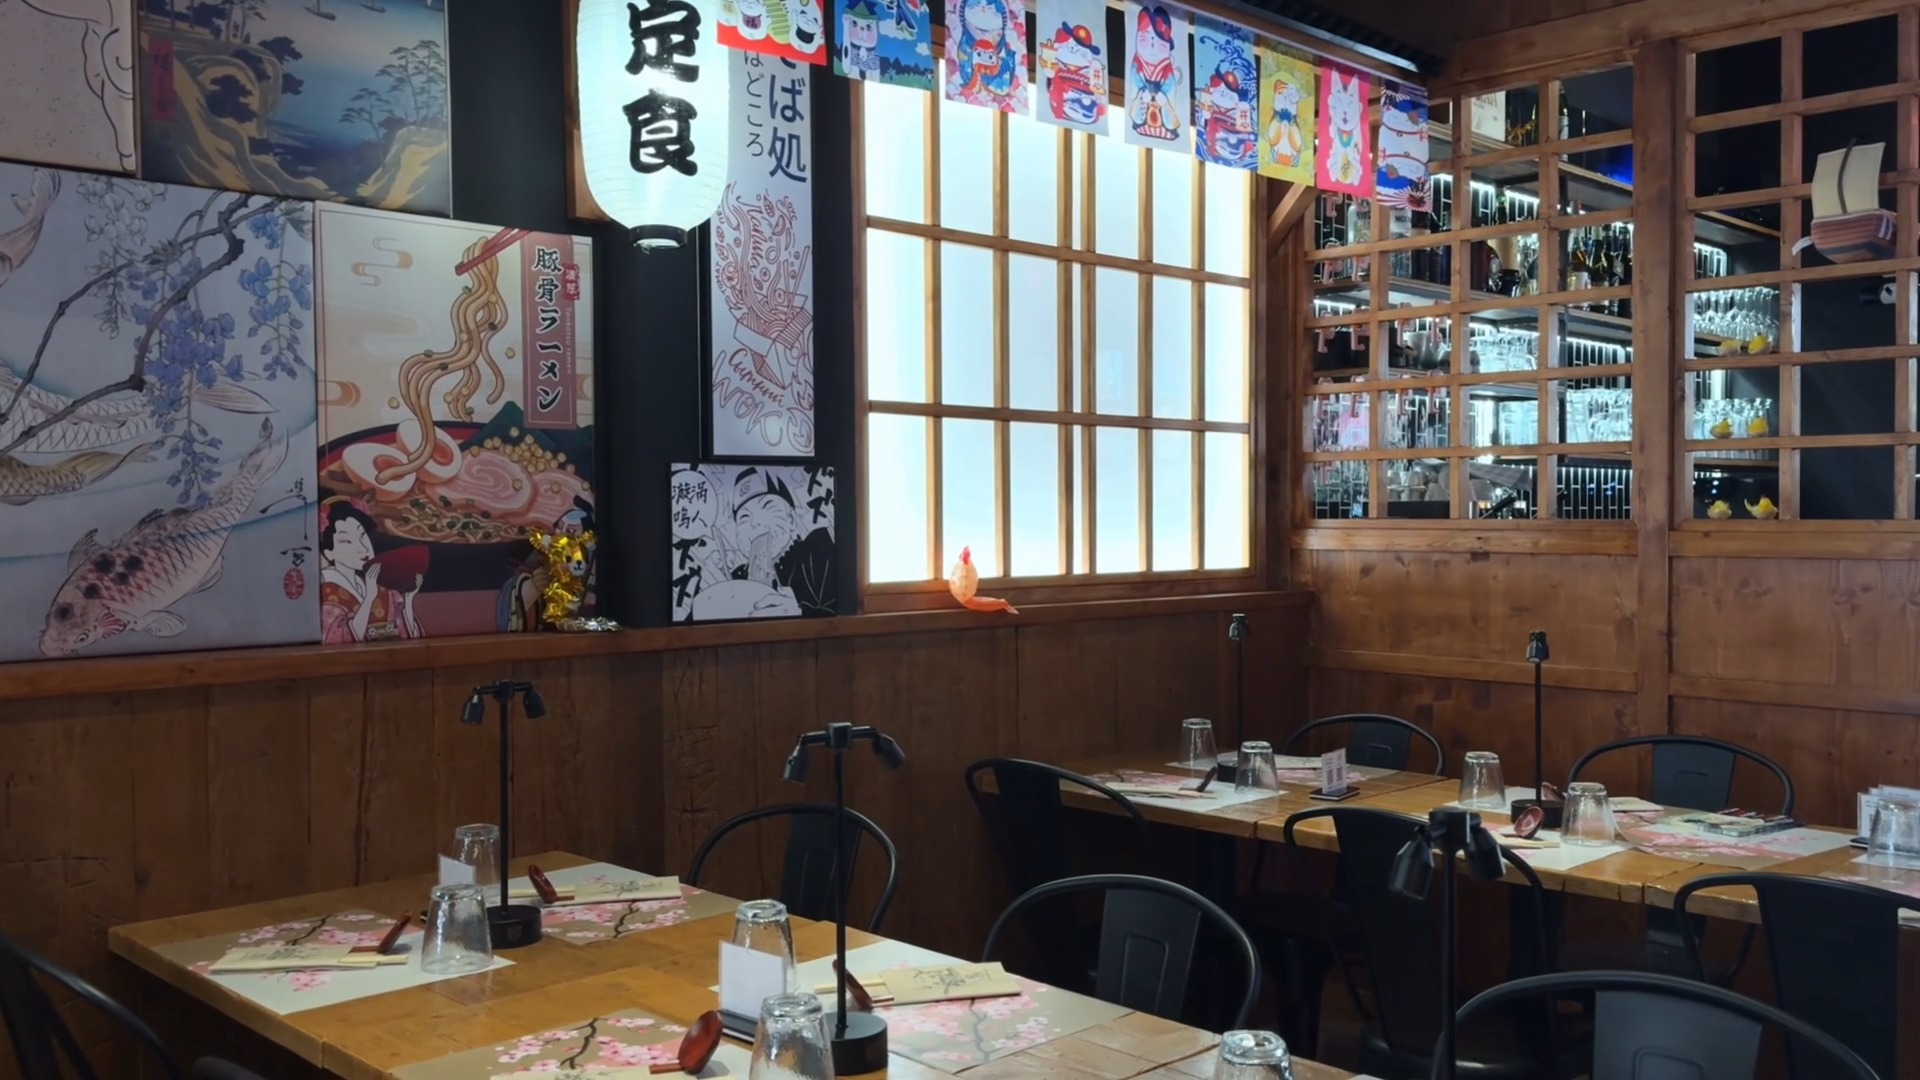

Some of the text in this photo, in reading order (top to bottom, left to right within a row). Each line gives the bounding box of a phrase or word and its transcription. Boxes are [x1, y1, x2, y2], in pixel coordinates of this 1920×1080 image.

[622, 0, 701, 176] 定食
[531, 246, 563, 411] 豚骨ラーメン
